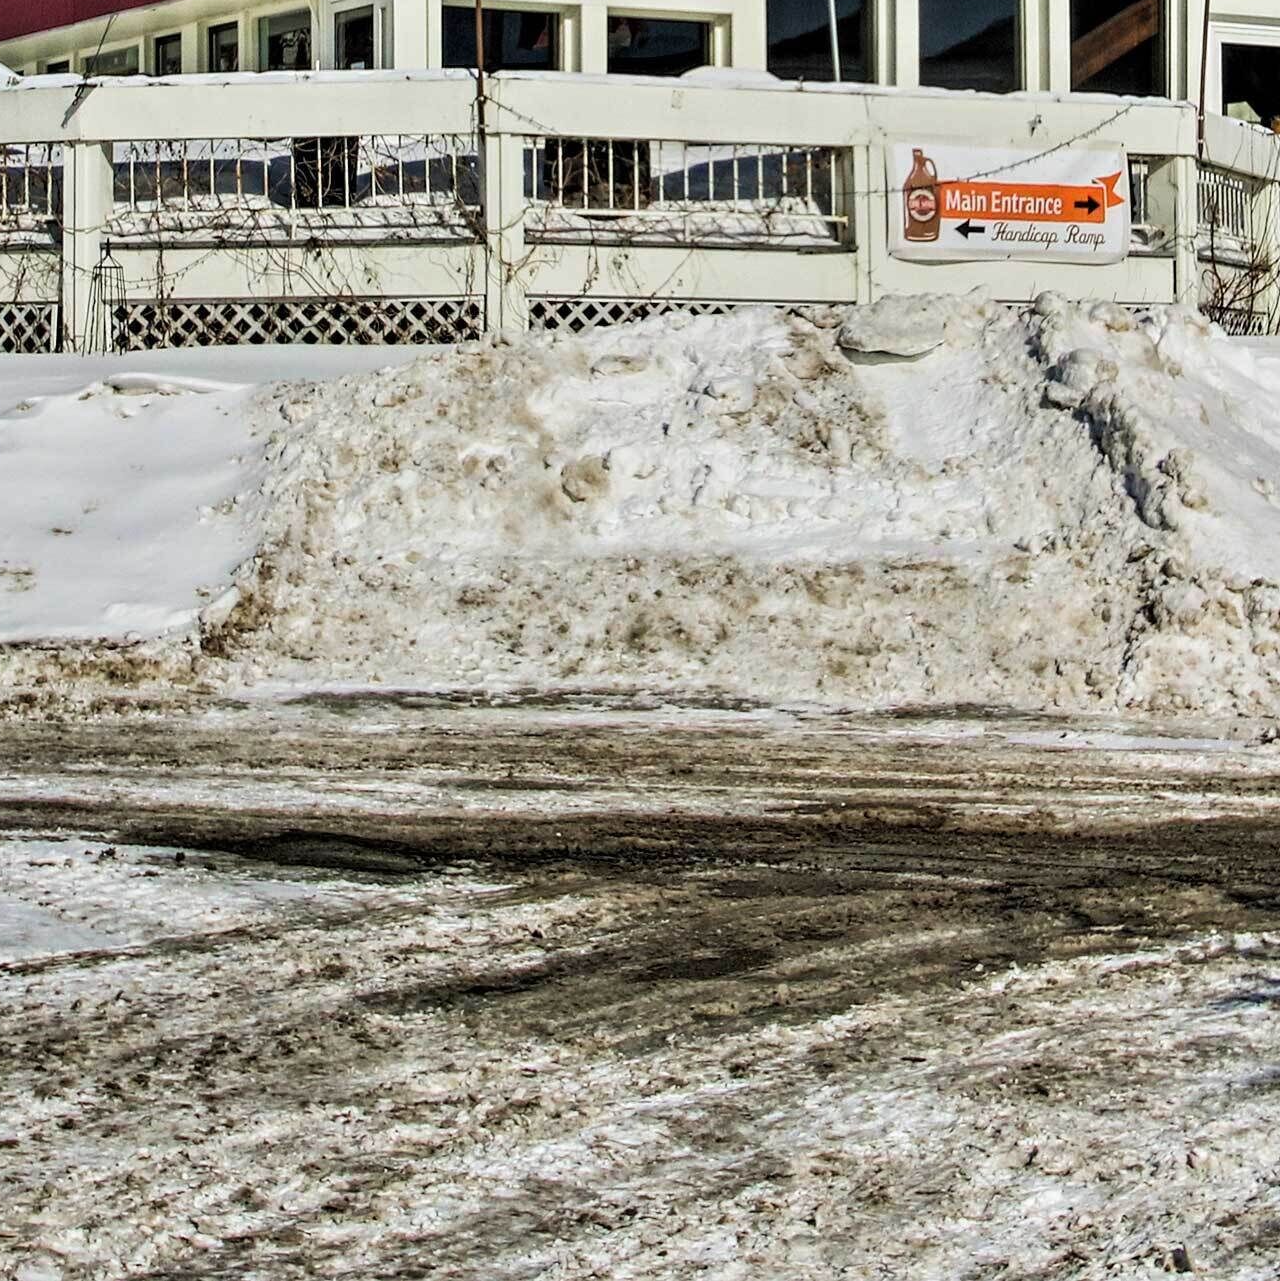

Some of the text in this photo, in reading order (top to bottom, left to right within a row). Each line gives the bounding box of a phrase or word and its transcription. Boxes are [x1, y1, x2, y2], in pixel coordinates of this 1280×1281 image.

[945, 189, 987, 212] Main
[991, 191, 1062, 215] Entrance
[991, 222, 1106, 252] Handicap Ramp
